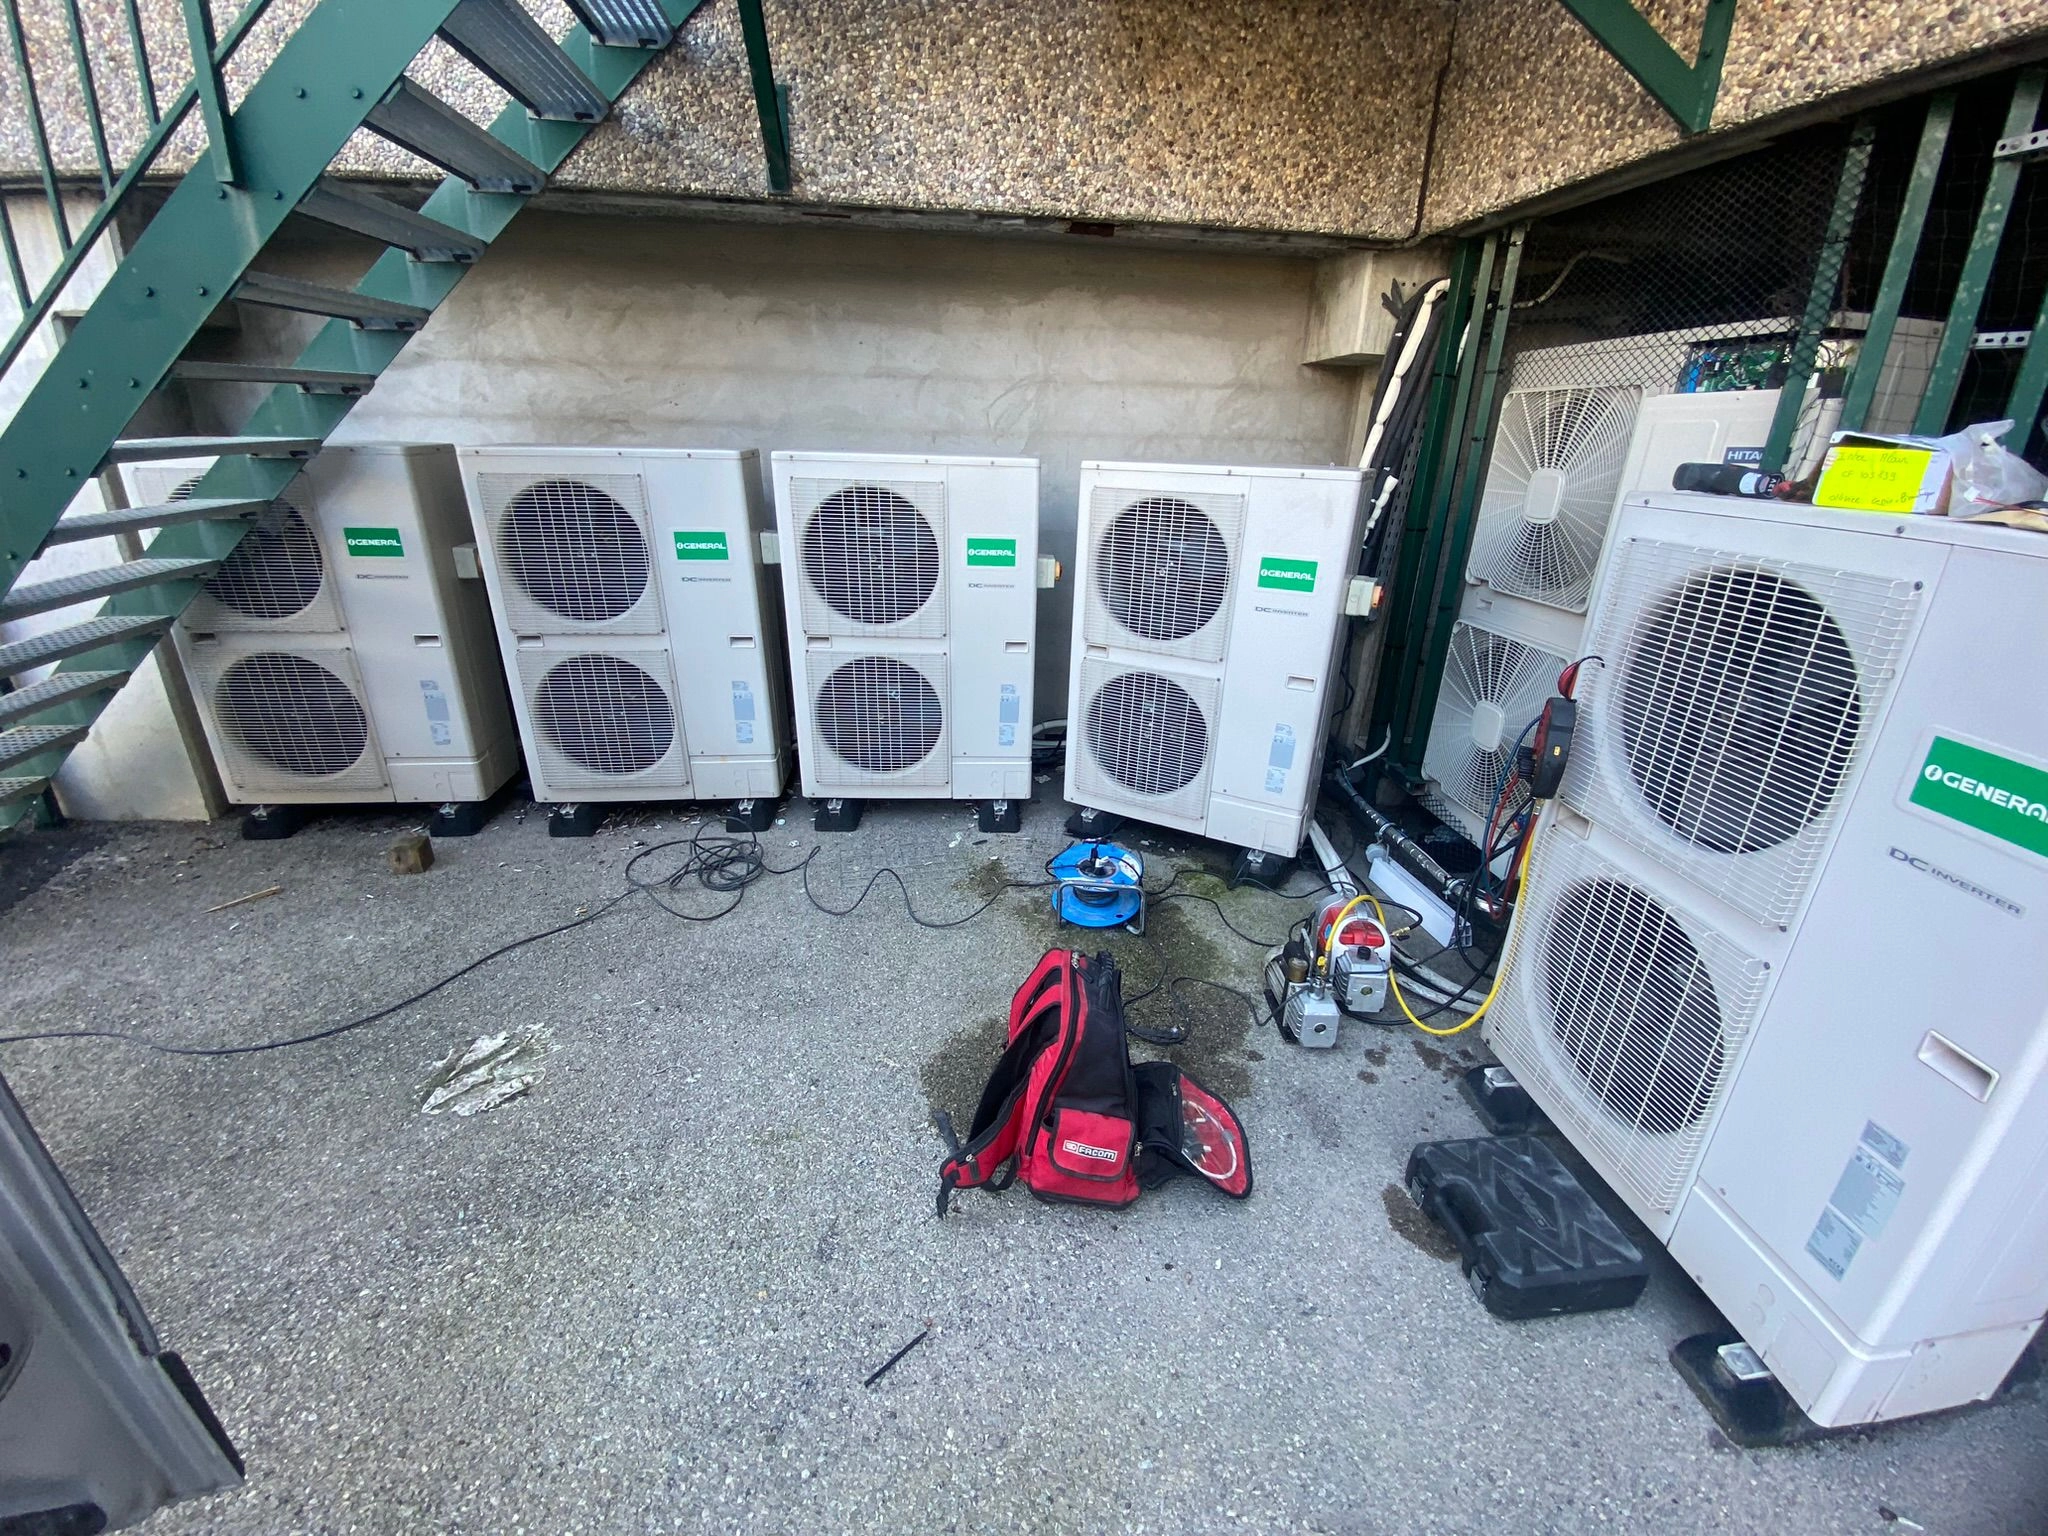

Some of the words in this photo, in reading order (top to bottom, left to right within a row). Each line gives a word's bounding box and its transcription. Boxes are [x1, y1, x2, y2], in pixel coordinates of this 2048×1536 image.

[1727, 450, 1763, 462] HITA
[355, 539, 401, 547] GENERAL
[975, 549, 1015, 557] GENERAL
[1267, 569, 1314, 581] GENERAL
[1942, 771, 2048, 824] GENERA
[1889, 847, 1929, 872] DC
[1931, 867, 2021, 914] INVERTER
[1078, 1145, 1116, 1160] FACOM
